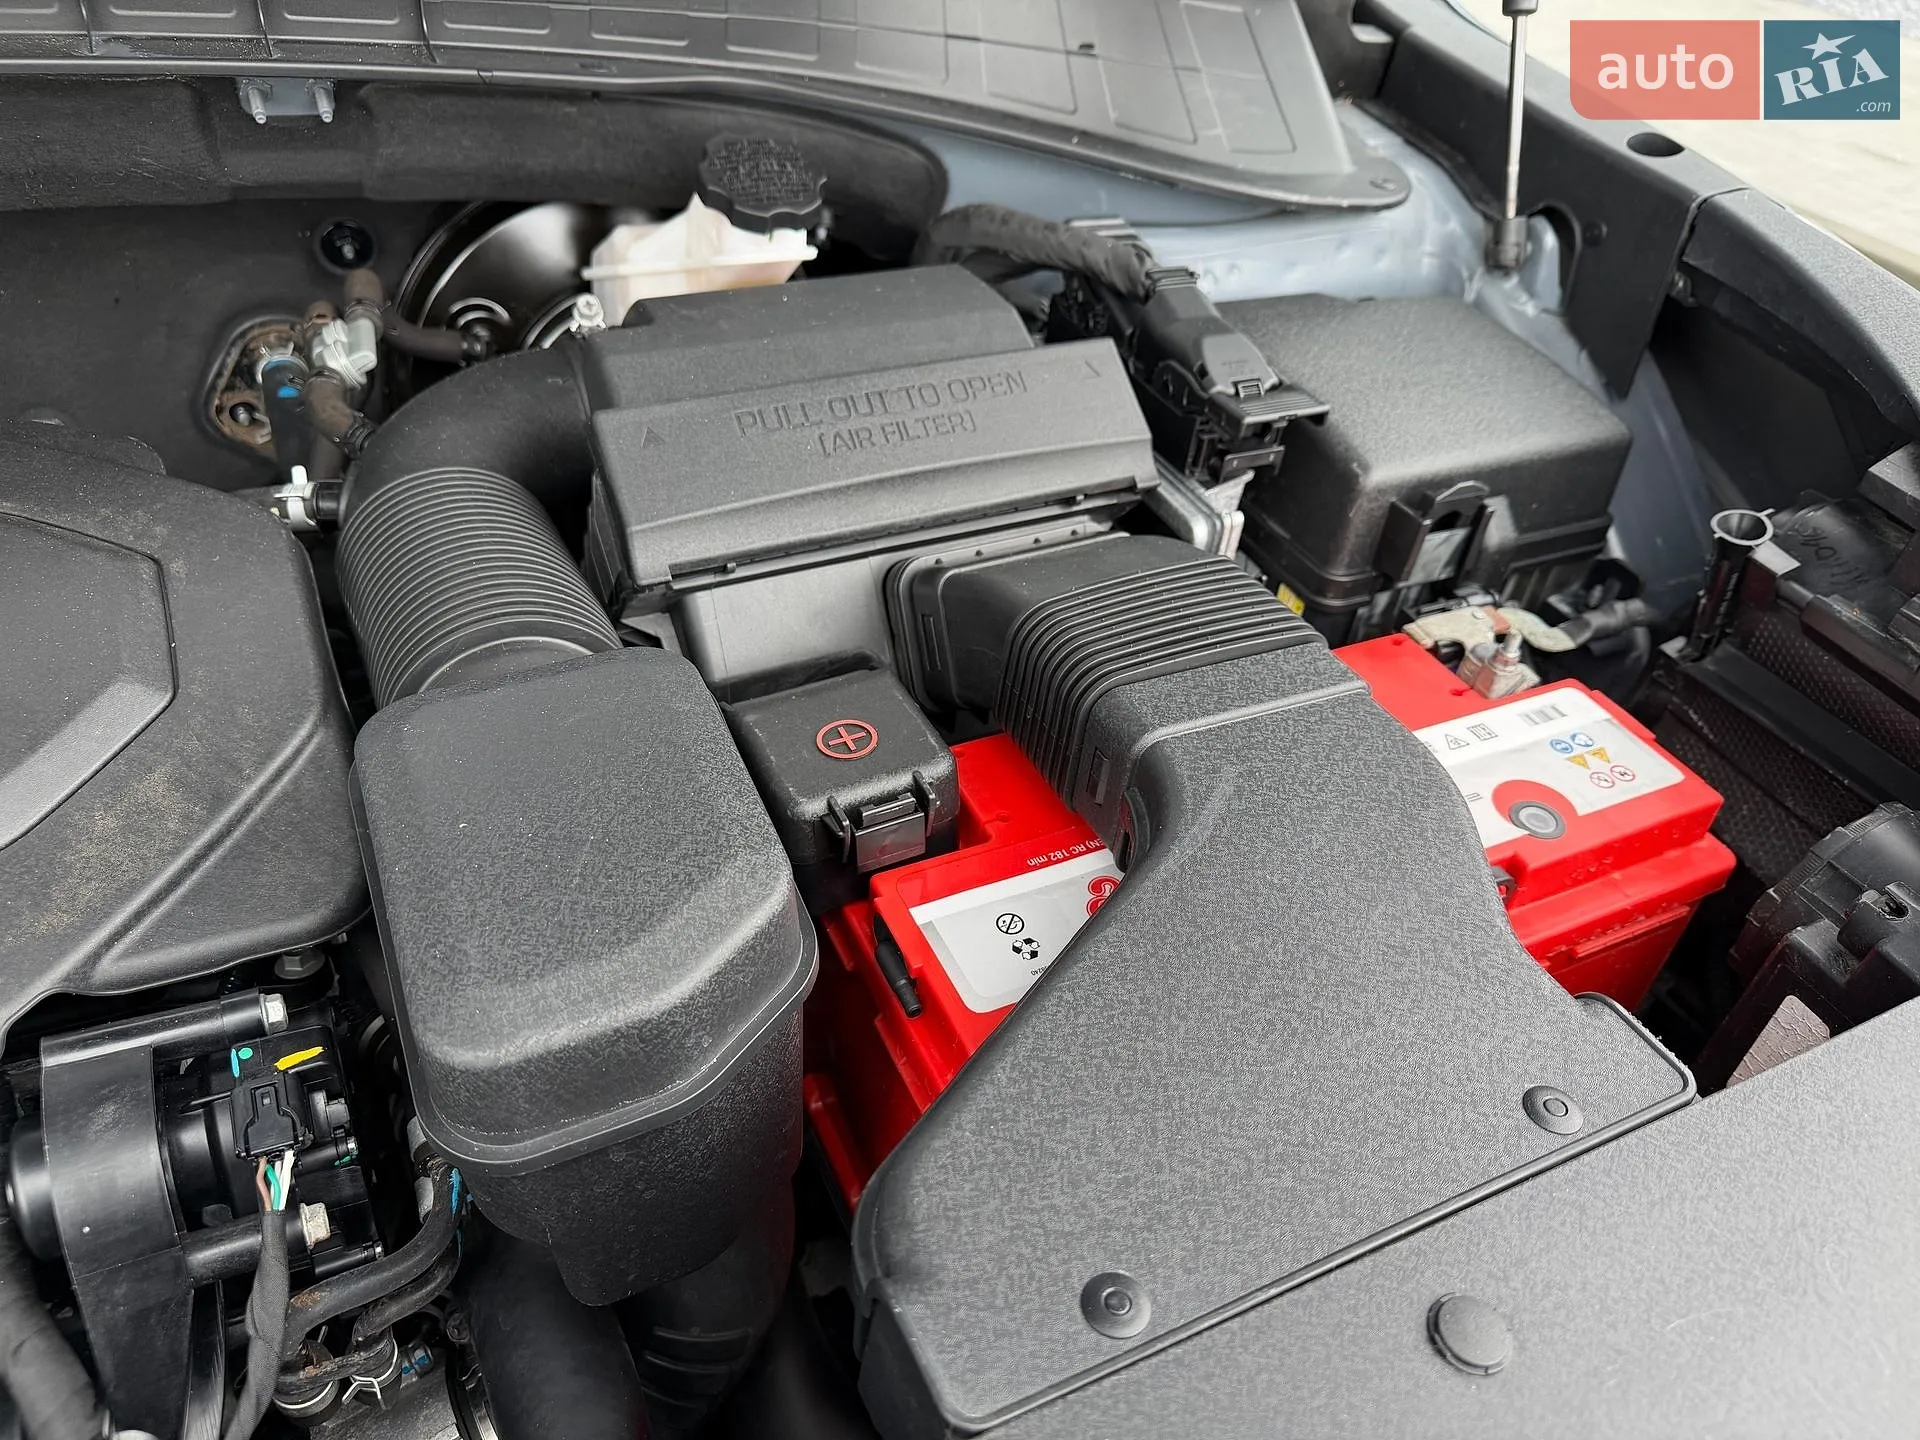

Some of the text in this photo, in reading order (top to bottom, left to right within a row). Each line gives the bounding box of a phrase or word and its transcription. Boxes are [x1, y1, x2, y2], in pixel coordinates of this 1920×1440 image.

[734, 370, 1028, 437] PULL OUT TO OPEN
[1048, 849, 1070, 861] 182
[1069, 843, 1087, 855] RC
[1026, 854, 1049, 867] min
